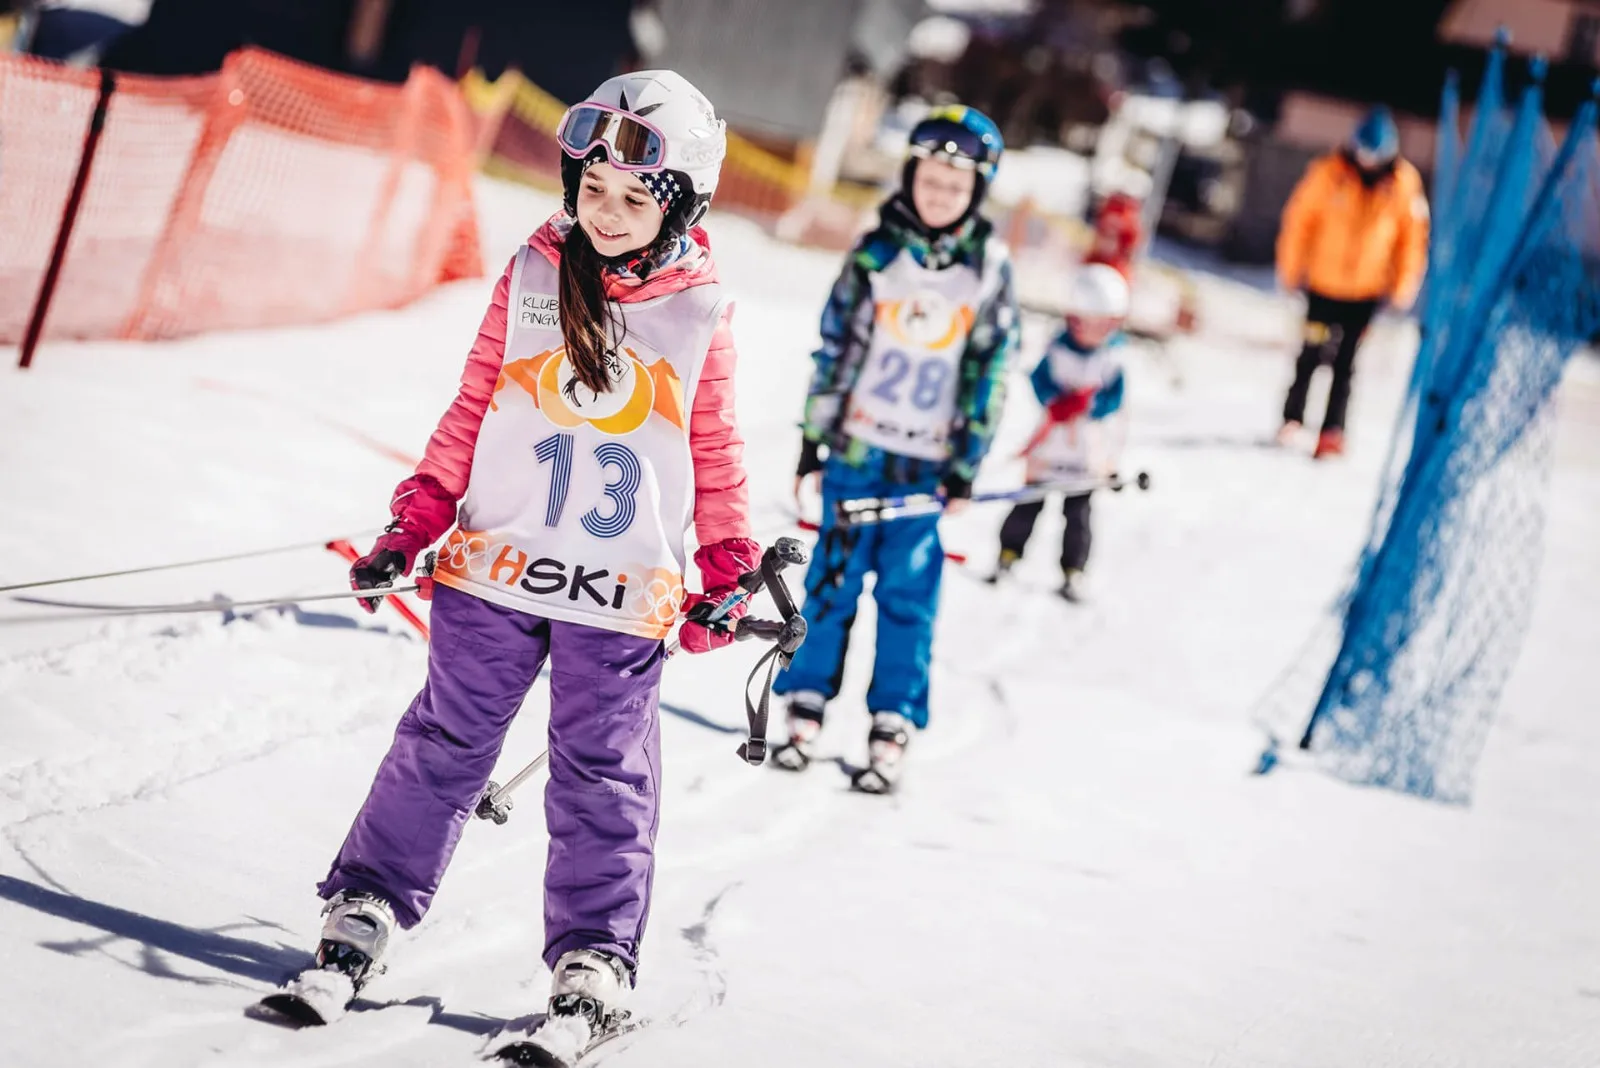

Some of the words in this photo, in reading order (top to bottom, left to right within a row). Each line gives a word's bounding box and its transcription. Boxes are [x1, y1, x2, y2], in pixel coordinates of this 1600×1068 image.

[522, 296, 559, 311] KLUB
[869, 350, 949, 411] 28
[533, 433, 642, 538] 13
